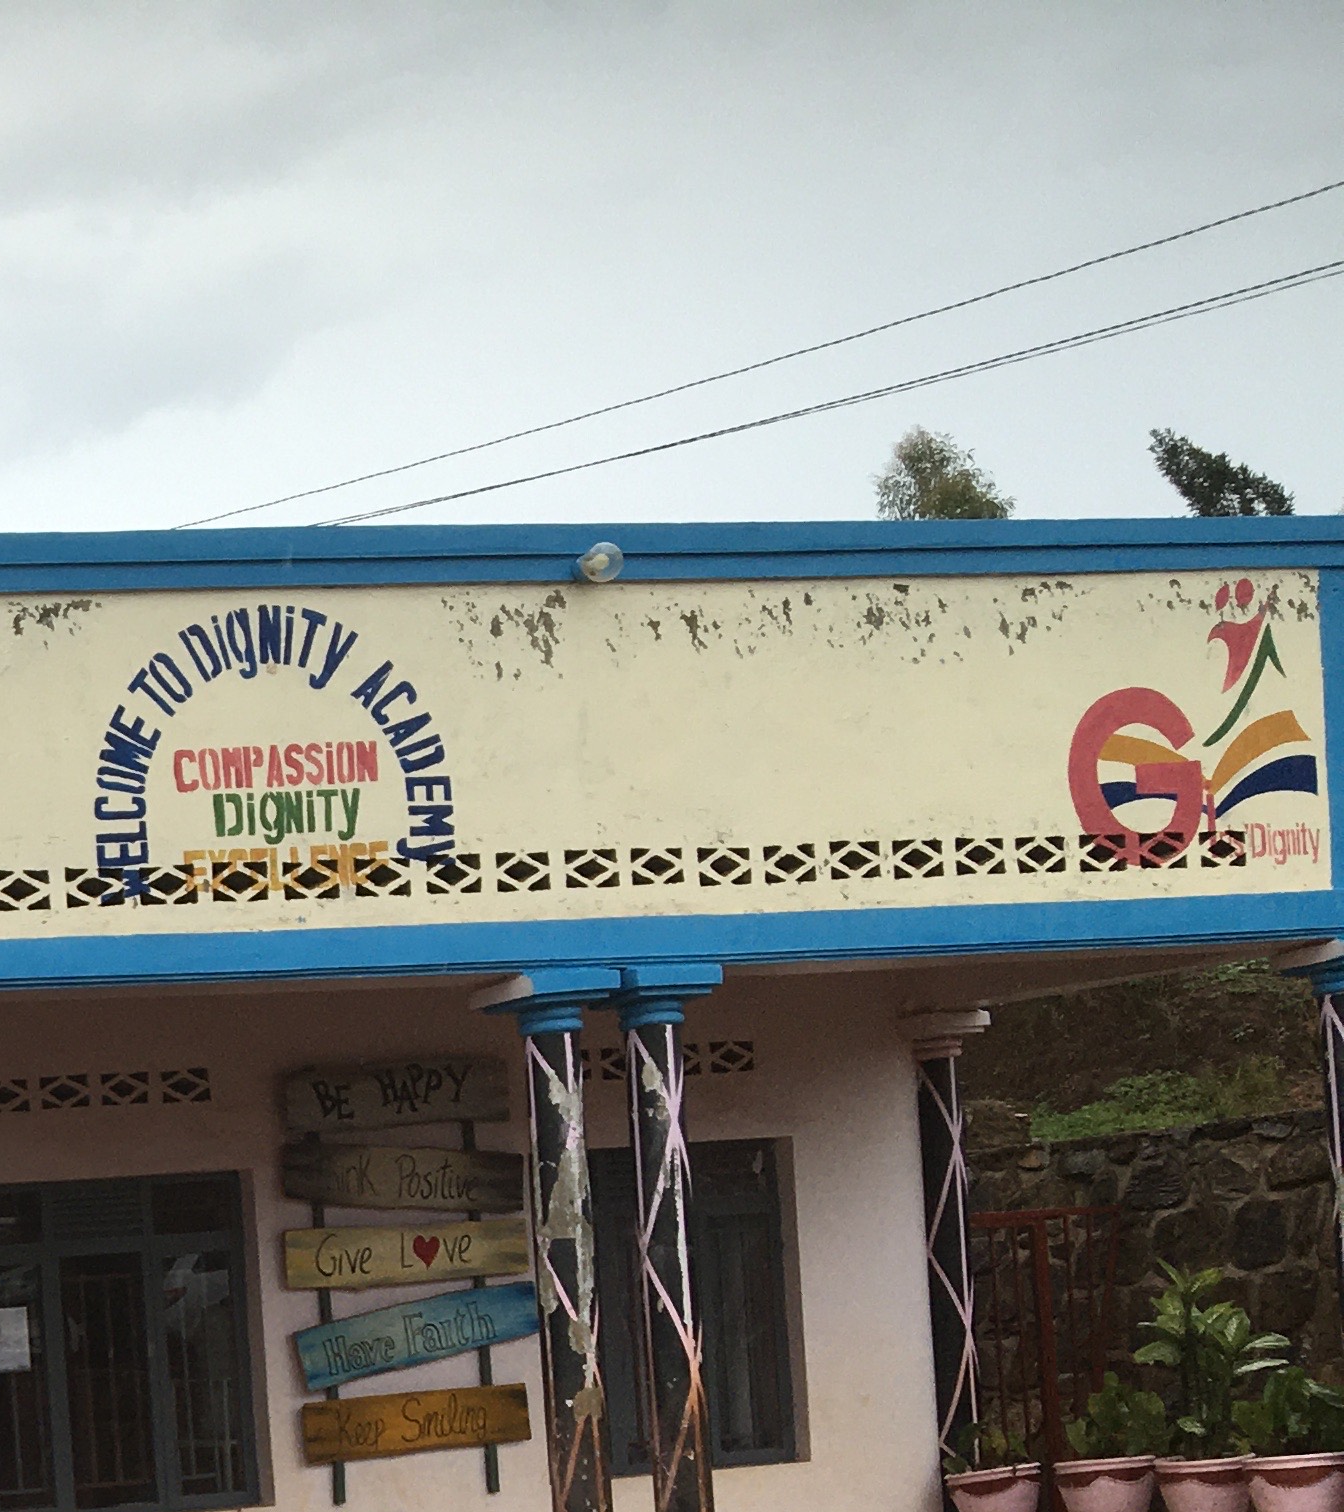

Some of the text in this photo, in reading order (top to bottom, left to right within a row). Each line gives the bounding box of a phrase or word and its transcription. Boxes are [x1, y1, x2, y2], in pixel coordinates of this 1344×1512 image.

[127, 652, 194, 718] TO
[312, 1062, 475, 1120] BE HAPPY
[402, 1301, 498, 1358] Faith
[401, 1400, 488, 1444] Smiling
